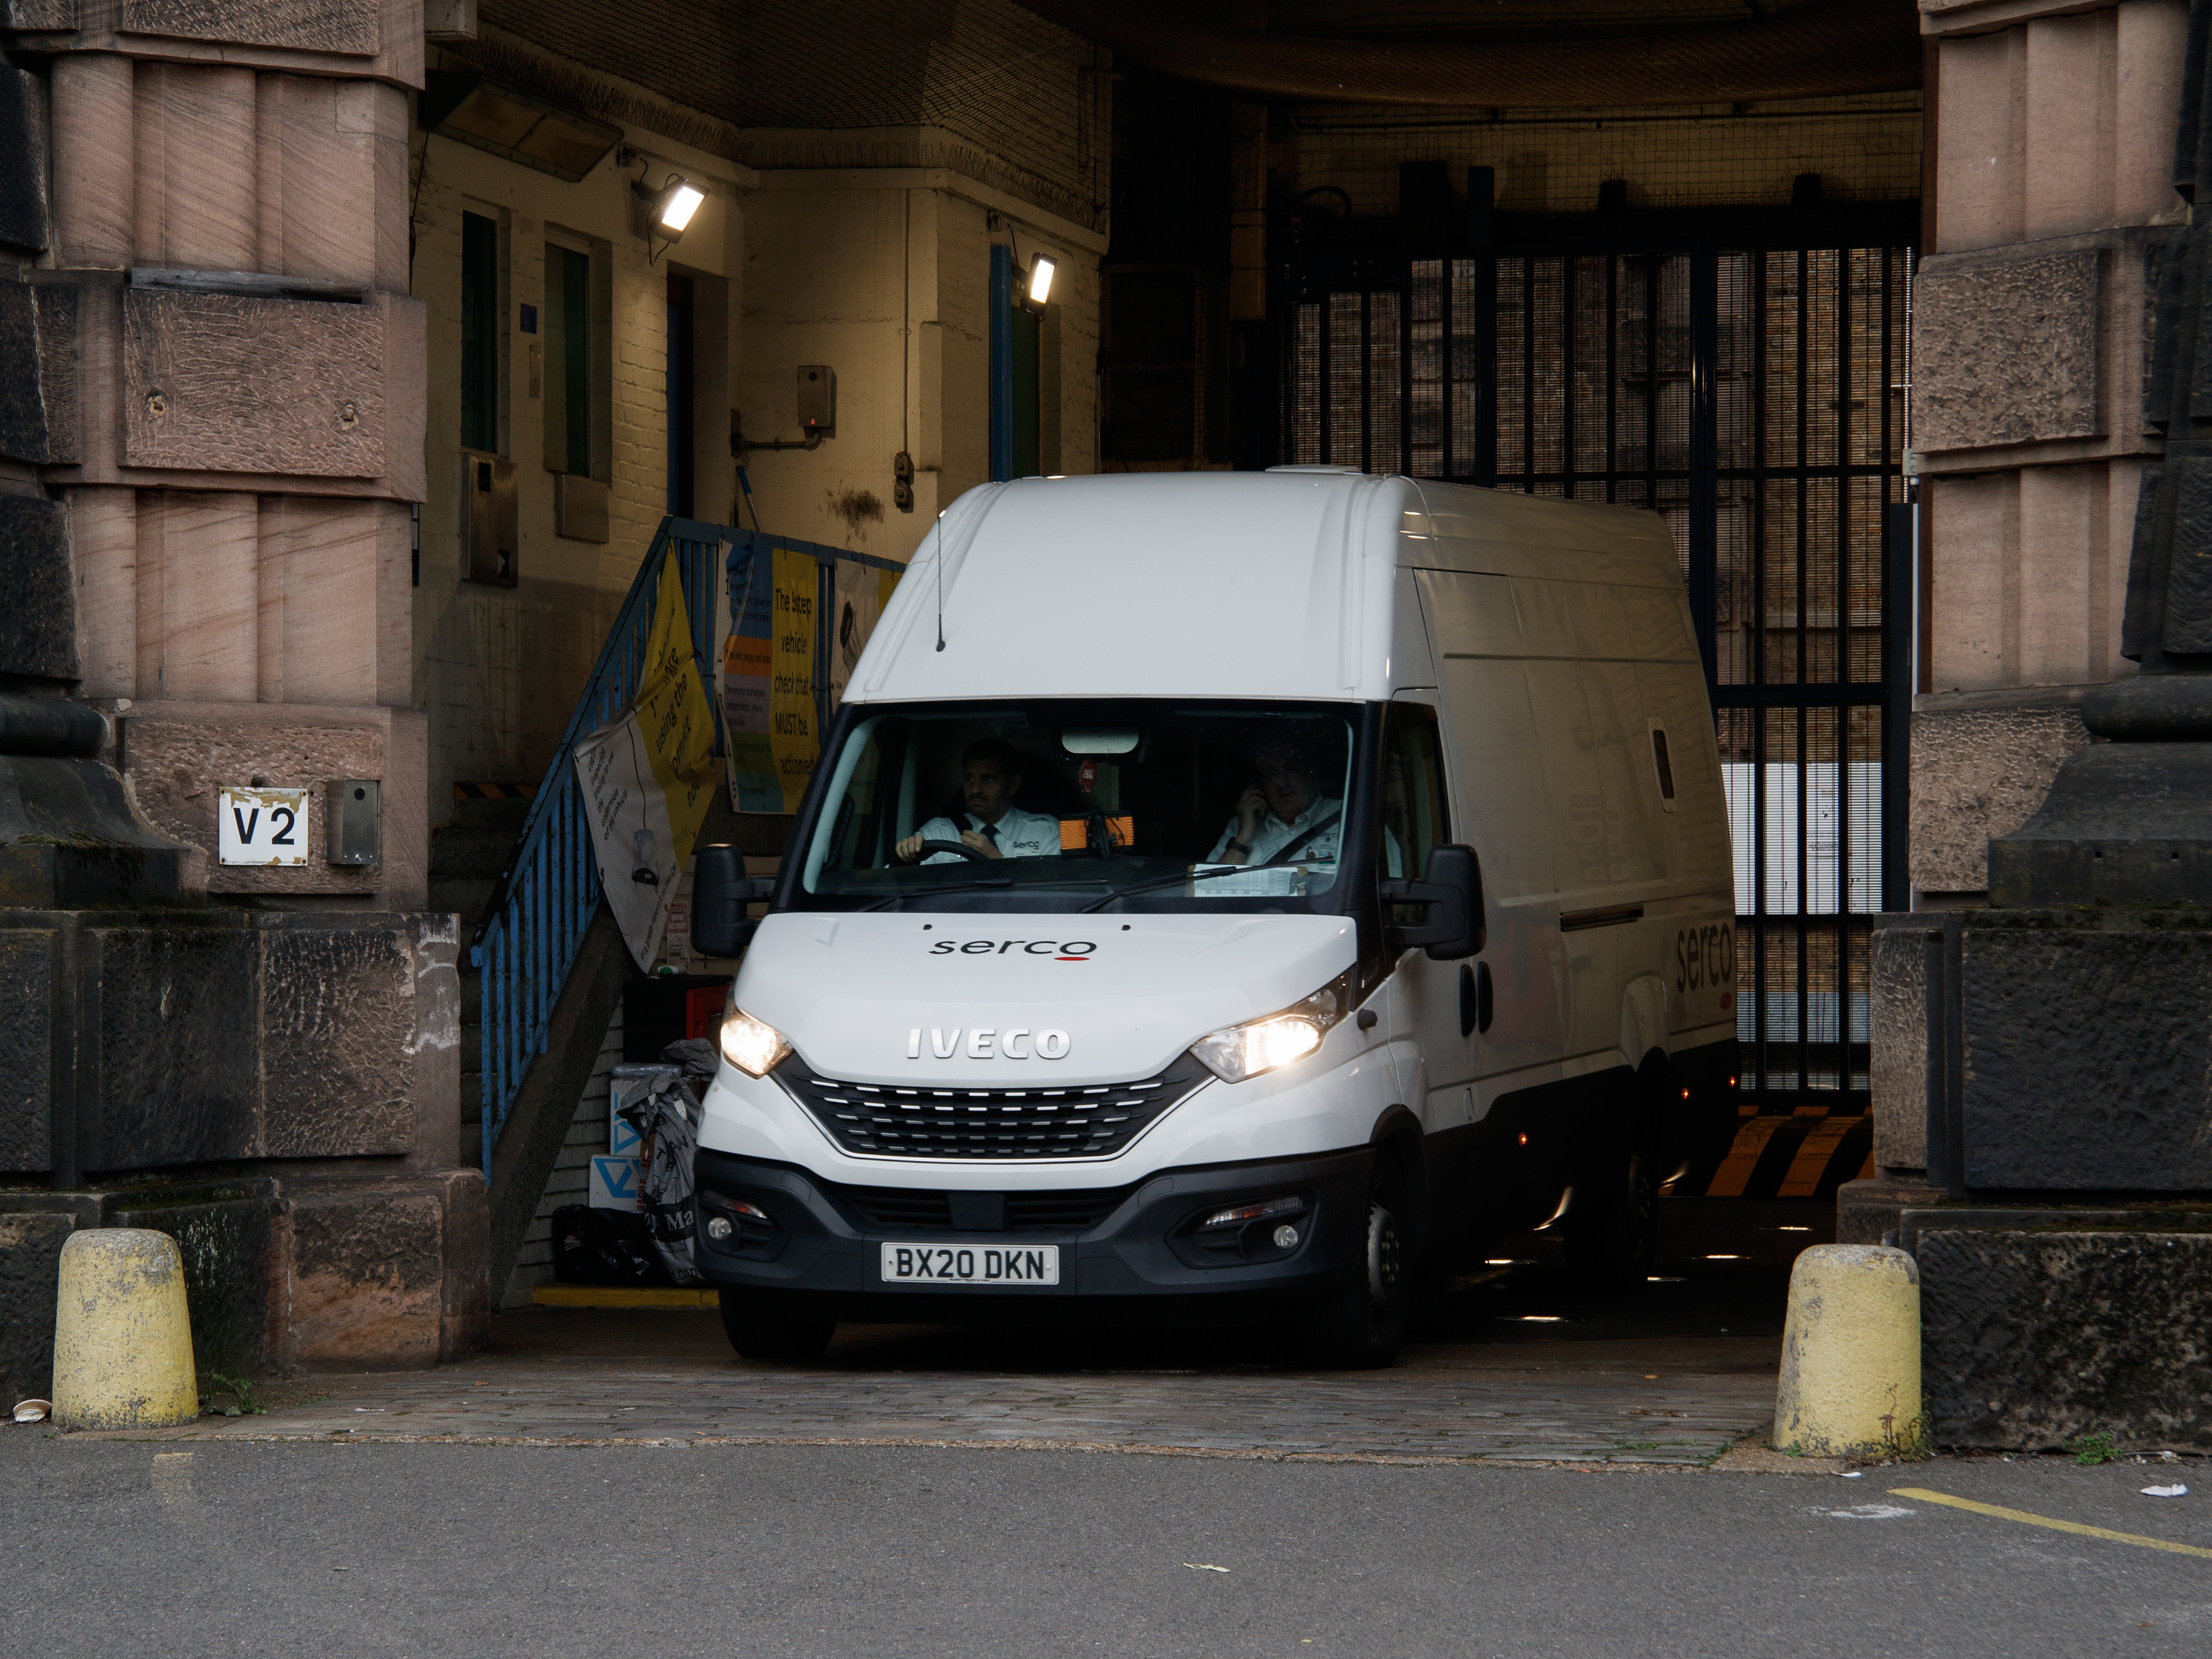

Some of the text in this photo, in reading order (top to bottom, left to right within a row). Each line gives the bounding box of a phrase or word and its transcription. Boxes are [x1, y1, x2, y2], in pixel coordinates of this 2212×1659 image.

[775, 588, 789, 611] The
[781, 630, 806, 655] vehicle
[774, 671, 809, 696] check that
[656, 672, 688, 755] using the
[775, 711, 809, 736] MUST be
[780, 753, 815, 775] actioned
[594, 773, 607, 800] trolley
[604, 764, 609, 776] to
[732, 781, 737, 799] 5
[601, 789, 619, 828] underside
[604, 826, 609, 840] of
[613, 789, 628, 818] vehicle
[929, 940, 1097, 956] serco
[1677, 923, 1732, 994] serco
[907, 1028, 1071, 1059] IVECO
[672, 1268, 698, 1281] LOAD
[896, 1249, 1044, 1279] BX20 DKN
